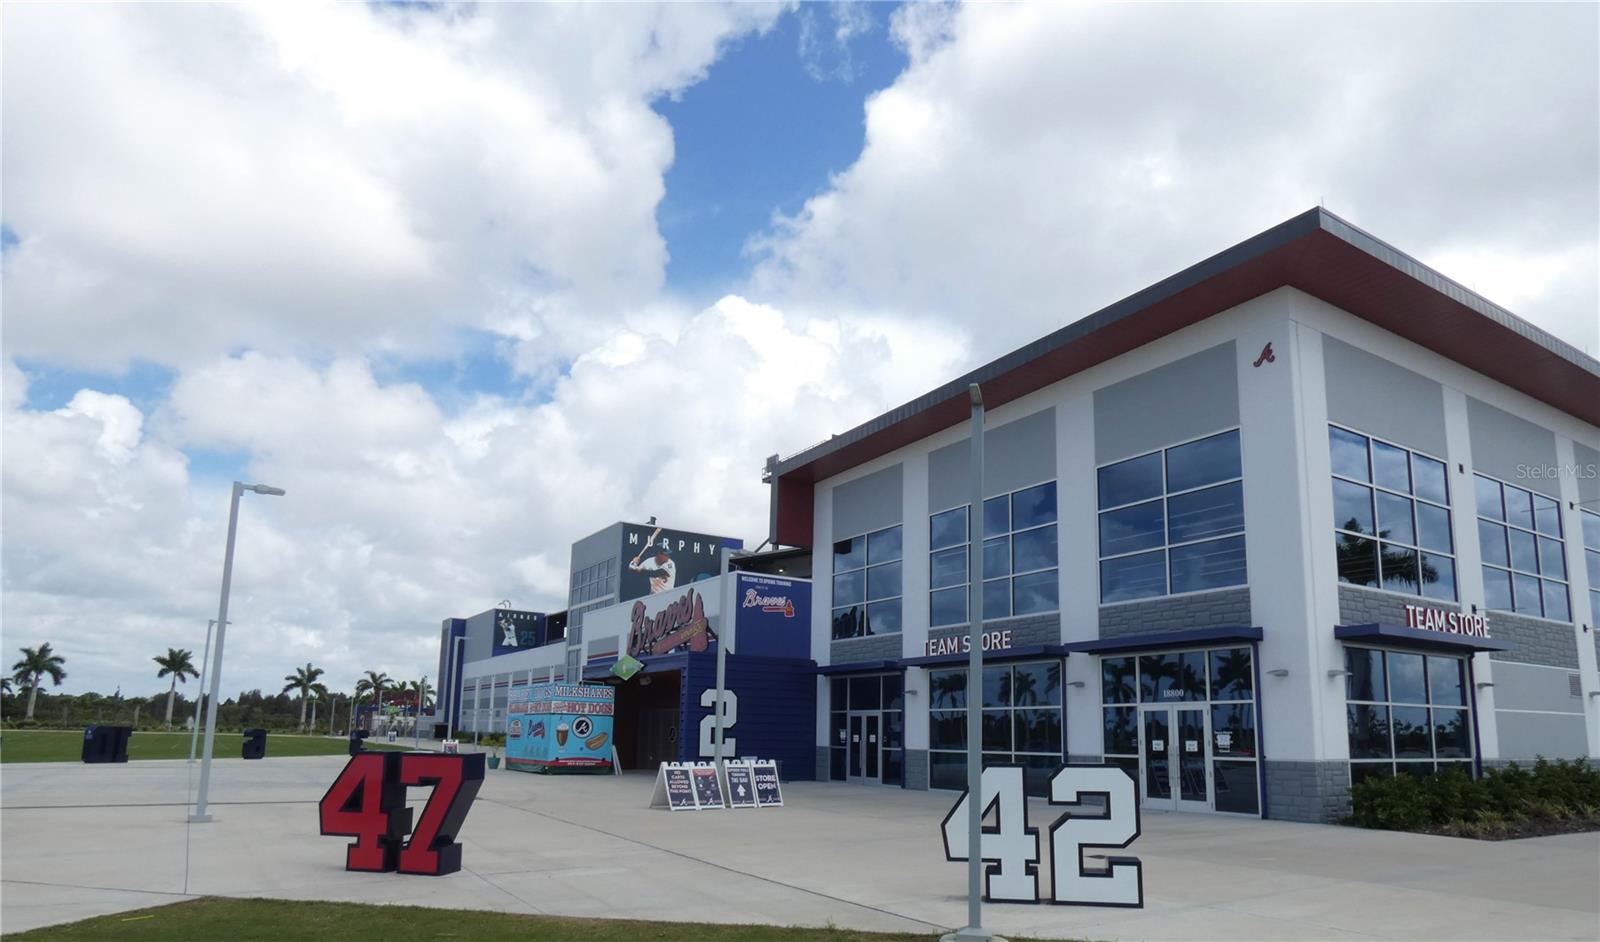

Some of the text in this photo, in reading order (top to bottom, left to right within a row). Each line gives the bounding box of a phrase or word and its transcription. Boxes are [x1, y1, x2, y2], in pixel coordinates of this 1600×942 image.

[629, 532, 716, 556] MURPHY
[742, 588, 787, 608] Braves
[627, 587, 694, 657] Braves
[1404, 604, 1492, 639] TEAM STORE
[519, 630, 536, 647] 25
[923, 630, 1012, 657] TEAM SORE
[554, 685, 614, 698] MILKSHAKES
[1163, 688, 1184, 697] 18800
[567, 702, 587, 713] HOT
[588, 703, 613, 714] DOGS
[699, 688, 738, 757] 2
[319, 751, 472, 876] 47
[941, 763, 1144, 909] 42
